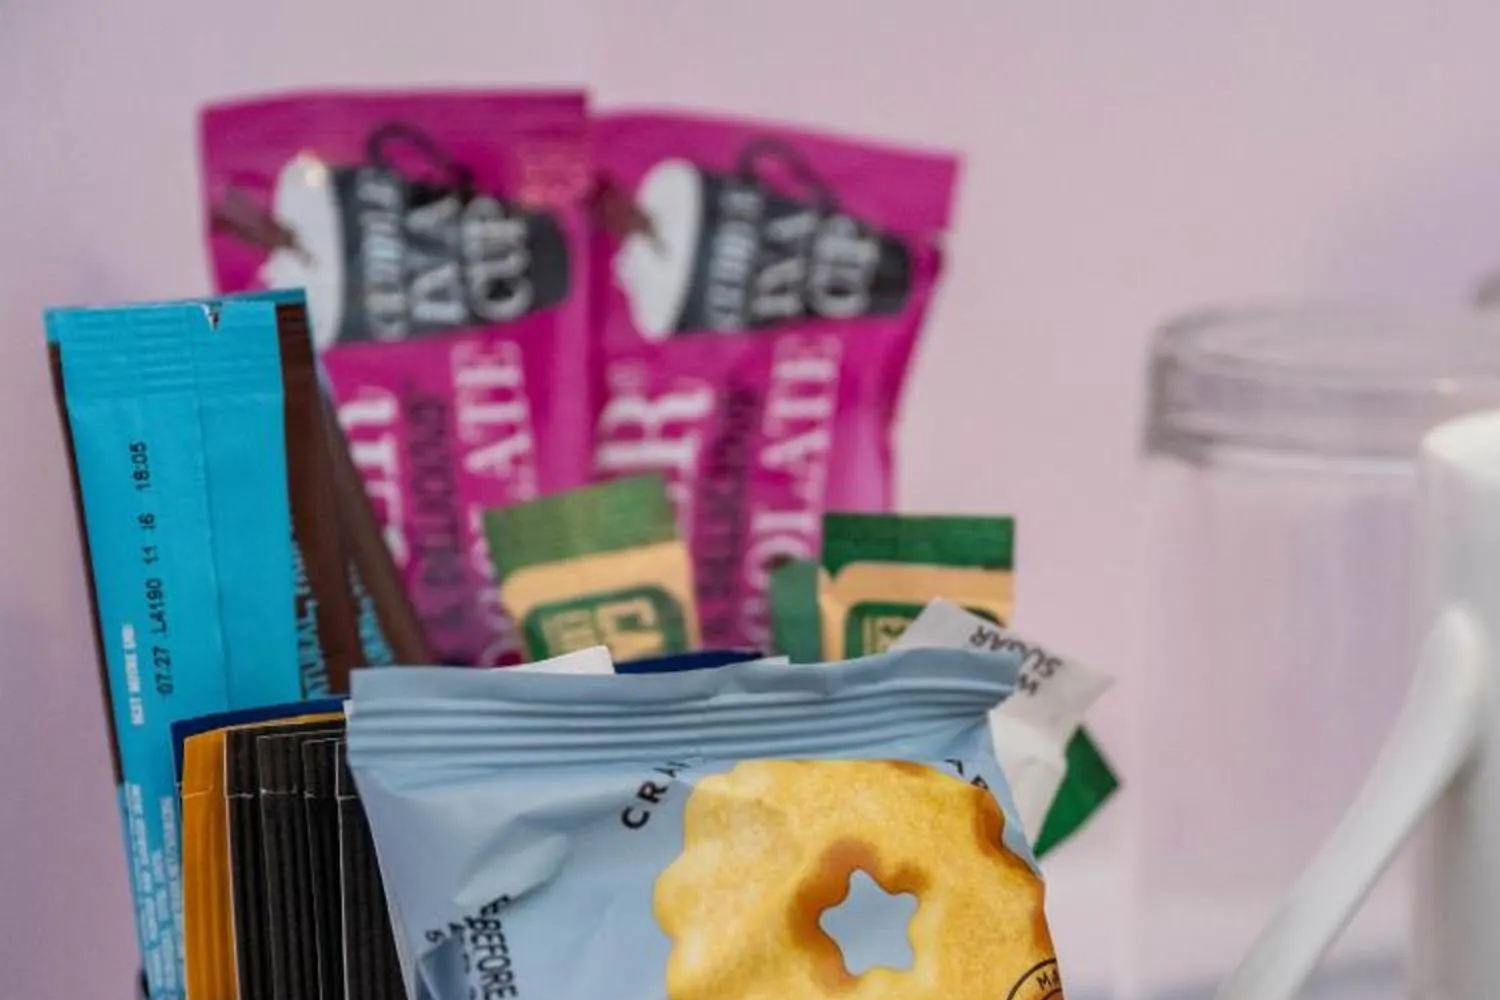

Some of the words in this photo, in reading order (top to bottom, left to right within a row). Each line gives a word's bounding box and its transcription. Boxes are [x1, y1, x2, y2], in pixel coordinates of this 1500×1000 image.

[409, 250, 467, 325] IN
[460, 195, 532, 323] CUP
[750, 247, 807, 317] IN
[809, 214, 879, 319] CUP
[129, 441, 153, 493] 18:05
